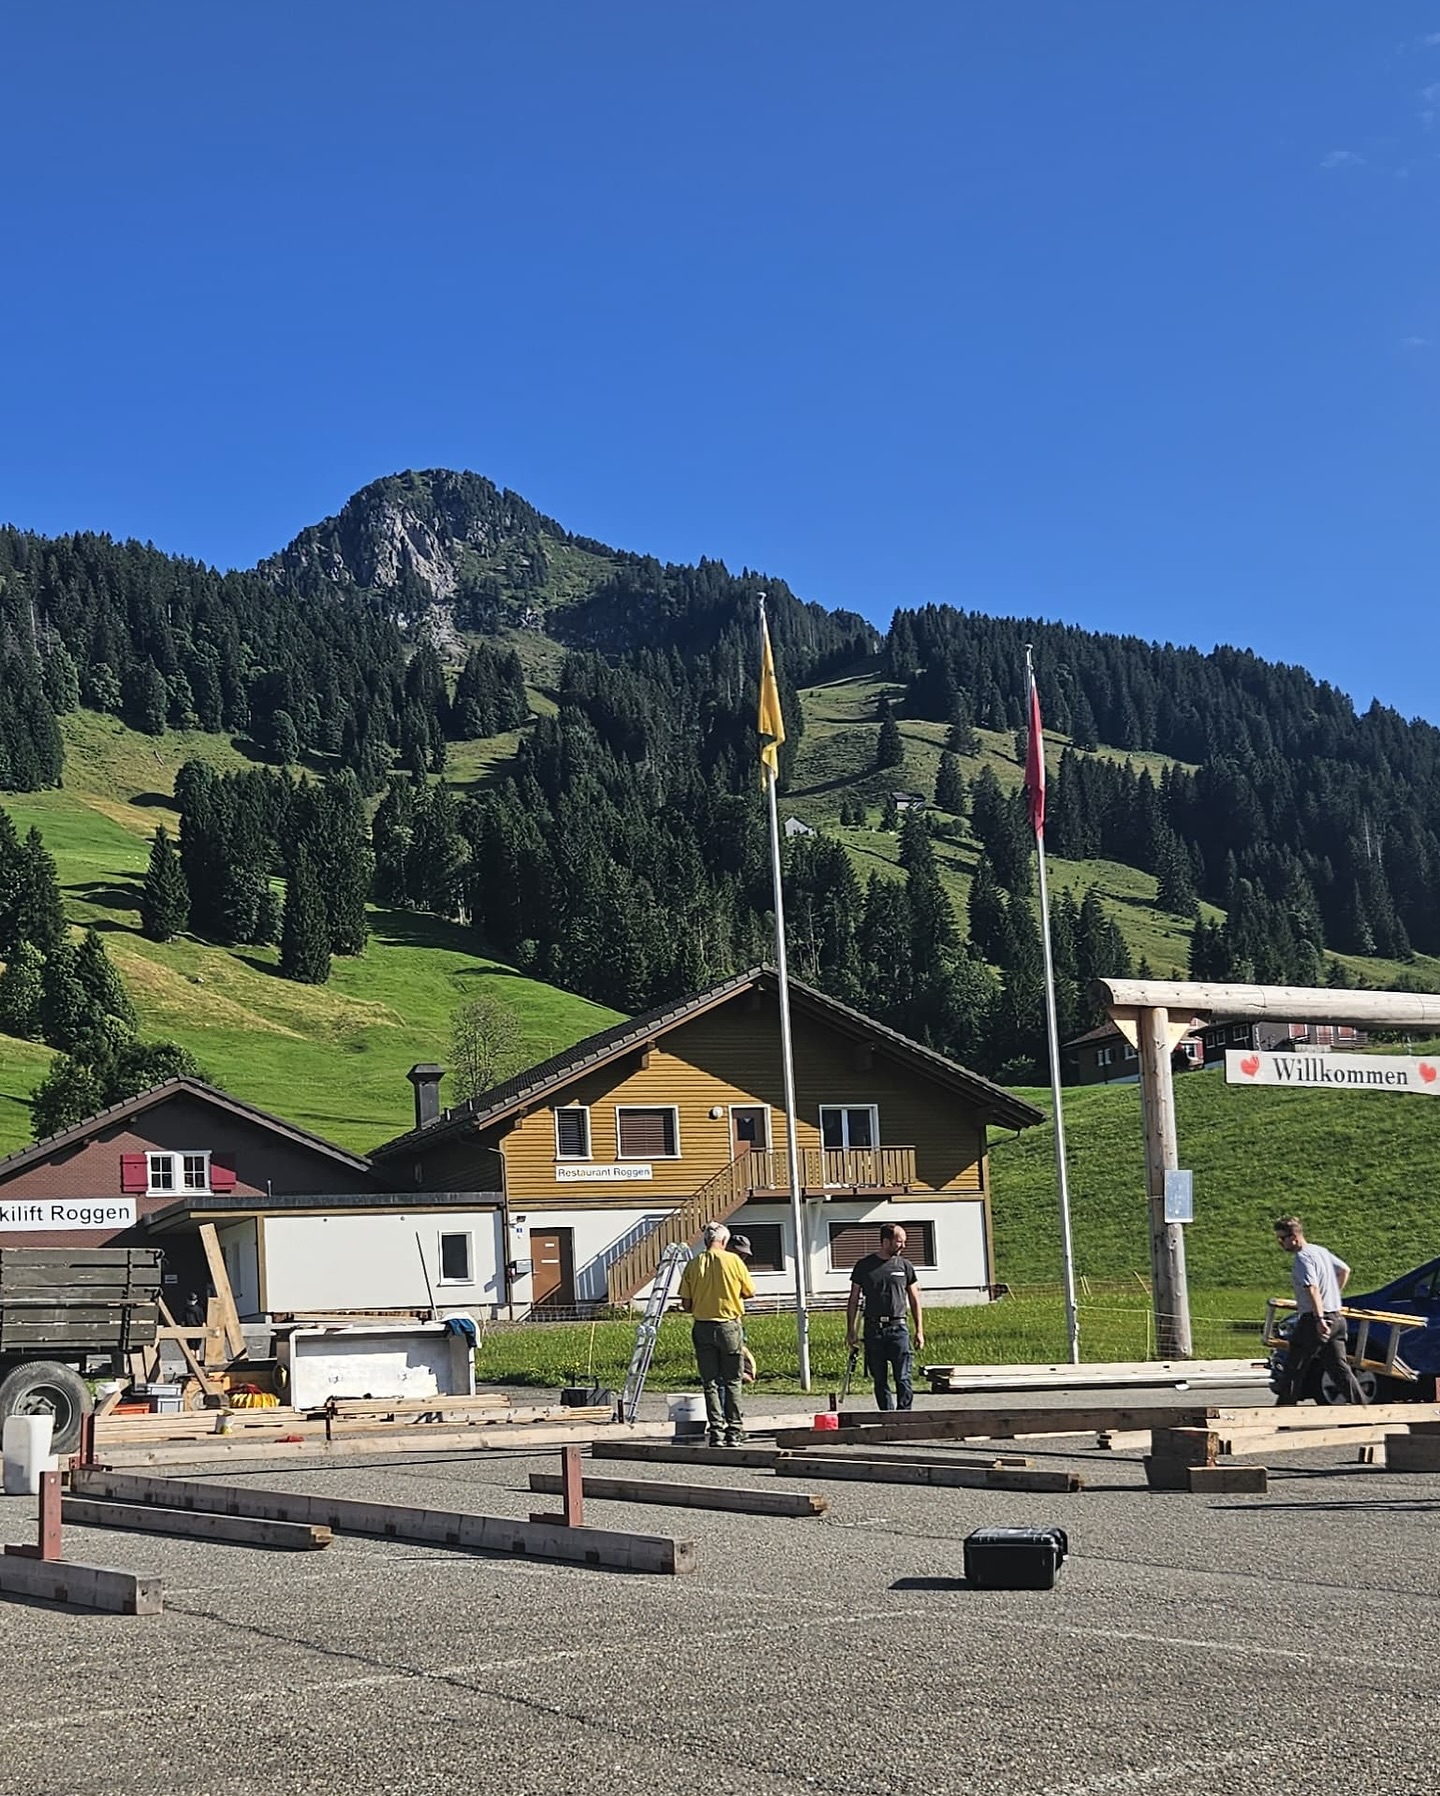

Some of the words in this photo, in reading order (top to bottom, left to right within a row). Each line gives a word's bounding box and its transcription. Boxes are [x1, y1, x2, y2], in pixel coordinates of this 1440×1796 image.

[1272, 1057, 1408, 1085] Willkommen
[557, 1168, 611, 1177] Restaurant
[613, 1167, 650, 1177] Roggen
[51, 1205, 130, 1224] Roggen
